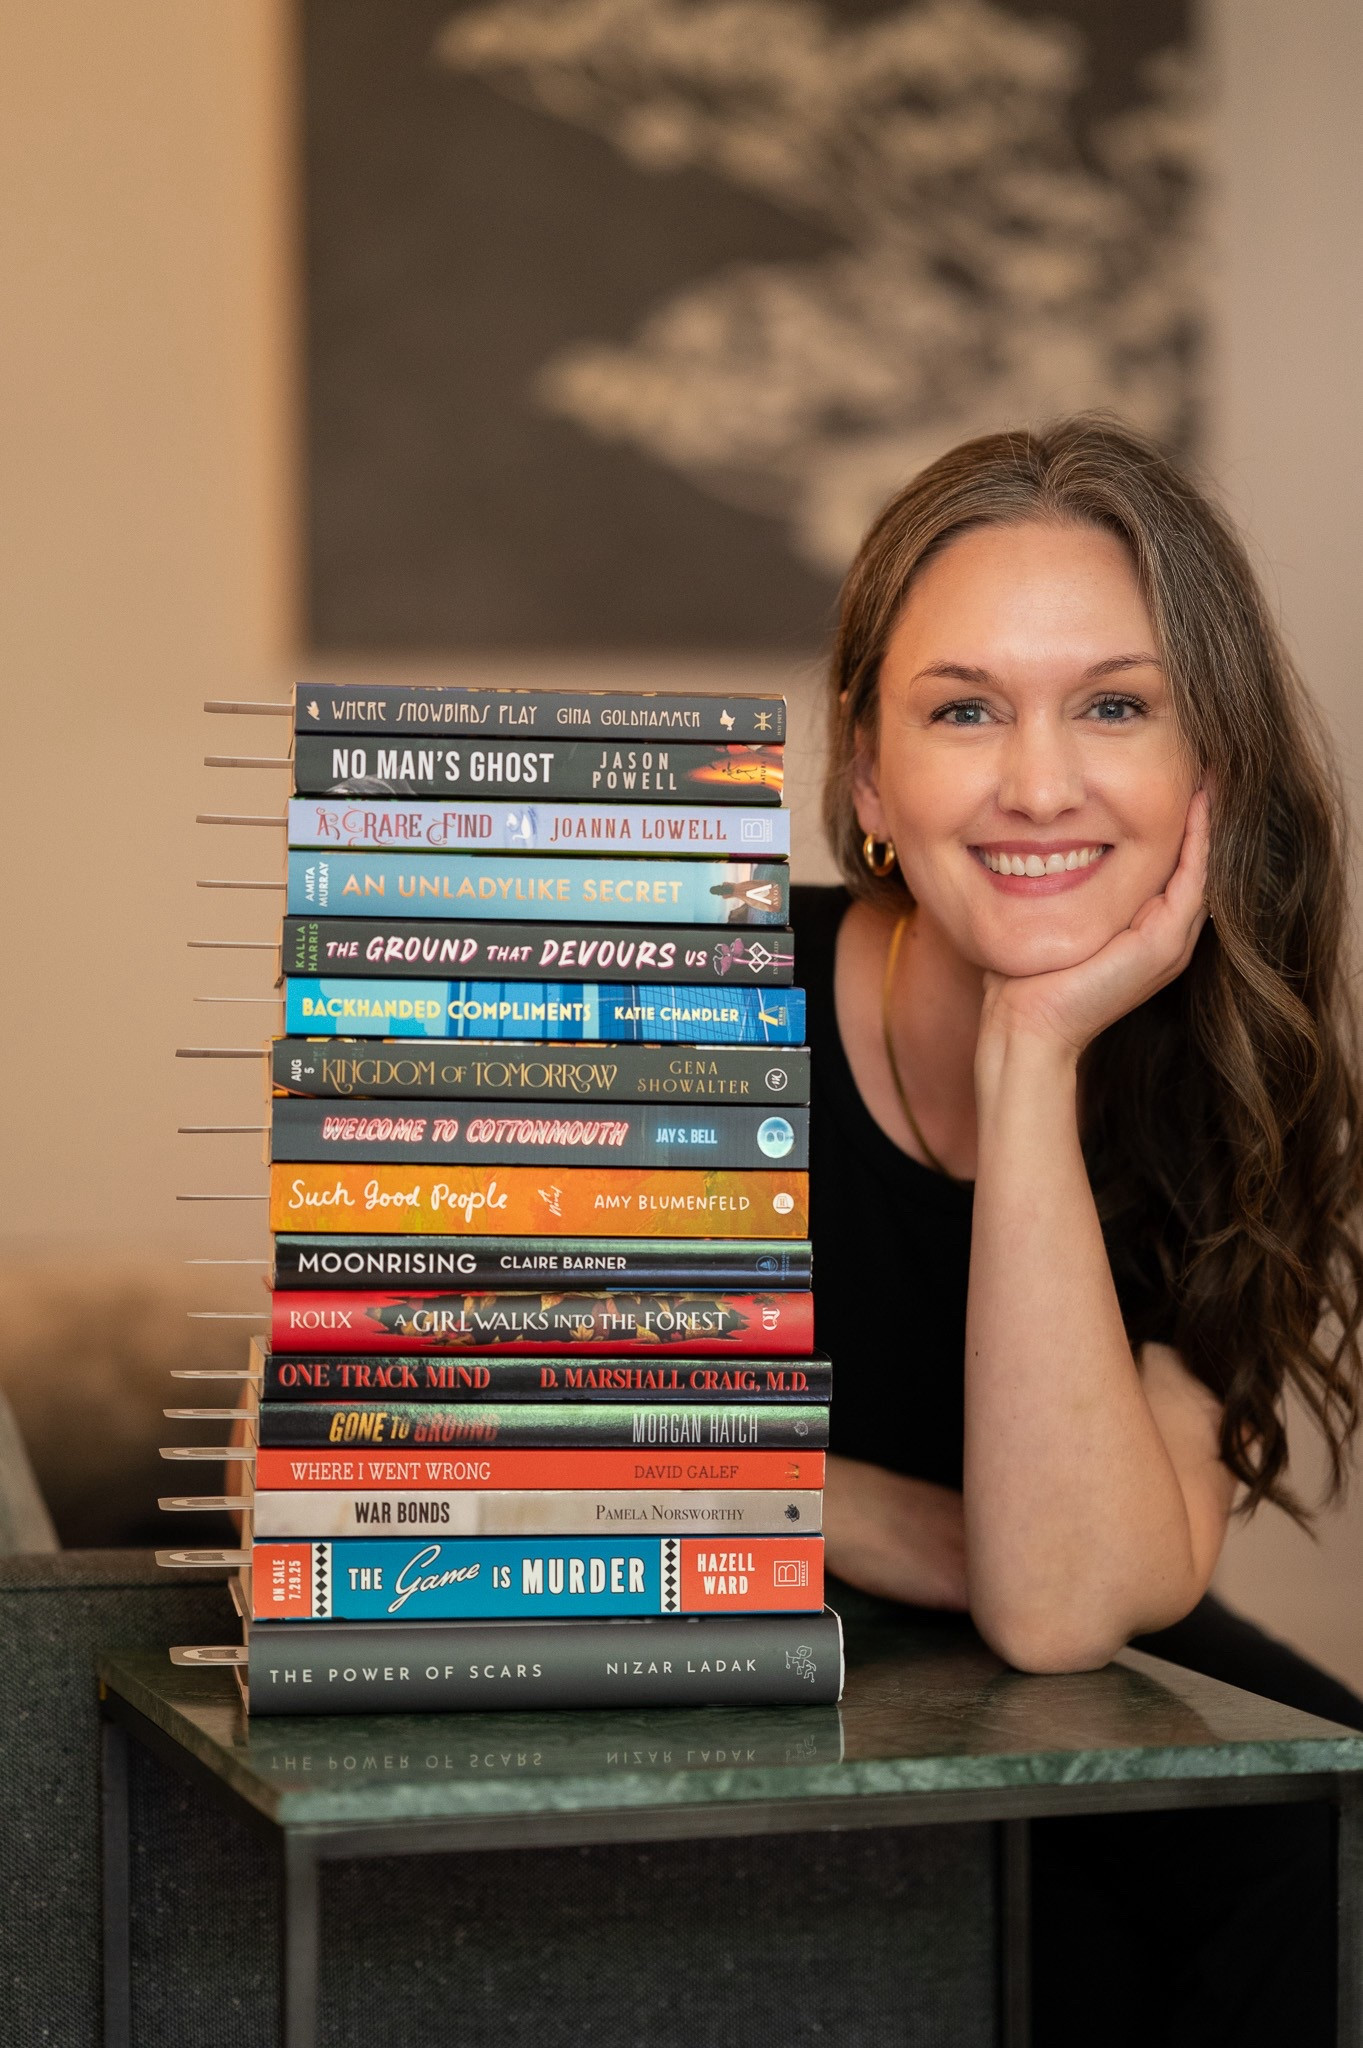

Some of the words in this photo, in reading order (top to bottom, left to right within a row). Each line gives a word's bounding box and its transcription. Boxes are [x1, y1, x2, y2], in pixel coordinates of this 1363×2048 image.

[331, 701, 386, 721] WHERE
[396, 702, 490, 723] SNOWBIRDS
[499, 705, 538, 725] PLAY
[556, 708, 592, 725] GINA
[600, 709, 700, 728] GOLDHAMMER
[332, 749, 366, 779] NO
[377, 750, 460, 781] MAN'S
[470, 752, 554, 783] GHOST
[600, 751, 669, 770] JASON
[592, 772, 677, 791] POWELL
[316, 806, 341, 840] A
[342, 806, 422, 845] RARE
[426, 813, 493, 845] FIND
[550, 817, 632, 842] JOANNA
[642, 818, 728, 841] LOWELL
[305, 866, 315, 901] AMITA
[319, 861, 329, 907] MURRAY
[342, 874, 385, 897] AN
[399, 876, 571, 901] UNLADYLIKE
[582, 879, 683, 904] SECRET
[295, 926, 305, 968] KALLA
[308, 923, 318, 971] HARRIS
[326, 941, 359, 958] THE
[366, 936, 478, 963] GROUND
[487, 945, 532, 962] THAT
[539, 939, 676, 970] DEVOURS
[685, 950, 708, 967] US
[302, 998, 441, 1019] BACKHANDED
[448, 1001, 591, 1022] COMPLIMENTS
[614, 1006, 655, 1021] KATIE
[660, 1007, 739, 1023] CHANDLER
[291, 1058, 302, 1082] AUG
[304, 1067, 315, 1075] 5
[322, 1058, 435, 1094] KINGDOM
[441, 1065, 467, 1084] OF
[471, 1061, 617, 1093] TOMORROW
[669, 1060, 718, 1075] GENA
[637, 1078, 749, 1094] SHOWALTER
[322, 1117, 427, 1142] WELCOME
[431, 1119, 458, 1143] TO
[465, 1119, 629, 1146] COTTONMOUTH
[655, 1128, 676, 1143] JAY
[677, 1128, 688, 1143] S.
[690, 1129, 718, 1144] BELL
[288, 1179, 355, 1209] Such
[431, 1181, 508, 1223] People
[538, 1189, 553, 1204] A
[594, 1194, 630, 1209] AMY
[639, 1195, 750, 1212] BLUMENFELD
[298, 1252, 477, 1274] MOONRISING
[500, 1256, 558, 1269] CLAIRE
[563, 1256, 627, 1270] BARNER
[290, 1311, 352, 1329] ROUX
[394, 1314, 407, 1327] A
[412, 1309, 472, 1333] GIRL
[474, 1311, 549, 1331] WALKS
[554, 1314, 595, 1330] INTO
[598, 1312, 636, 1331] THE
[645, 1311, 729, 1331] FOREST
[278, 1363, 330, 1388] ONE
[336, 1364, 418, 1388] TRACK
[426, 1365, 491, 1389] MIND
[540, 1368, 558, 1388] D.
[565, 1368, 685, 1389] MARSHALL
[690, 1370, 761, 1392] CRAIG,
[766, 1371, 809, 1391] M.D.
[329, 1411, 387, 1442] GONE
[390, 1415, 411, 1440] TO
[413, 1412, 499, 1443] GROUND
[632, 1413, 701, 1443] MORGAN
[709, 1413, 758, 1443] HATCH
[290, 1462, 354, 1481] WHERE
[358, 1463, 364, 1481] I
[368, 1462, 422, 1481] WENT
[426, 1462, 491, 1481] WRONG
[634, 1465, 683, 1479] DAVID
[686, 1465, 739, 1479] GALEF
[355, 1502, 391, 1524] WAR
[397, 1502, 450, 1523] BONDS
[273, 1559, 285, 1585] SALE
[697, 1553, 756, 1573] HAZELL
[289, 1560, 302, 1600] 7.29.25
[348, 1568, 383, 1590] THE
[387, 1544, 481, 1614] Game
[492, 1565, 511, 1588] IS
[522, 1557, 645, 1594] MURDER
[703, 1575, 749, 1595] WARD
[273, 1588, 285, 1602] ON
[270, 1669, 313, 1684] THE
[329, 1667, 410, 1682] POWER
[425, 1666, 454, 1680] OF
[469, 1664, 542, 1679] SCARS
[606, 1661, 672, 1675] NIZAR
[687, 1659, 756, 1674] LADAK
